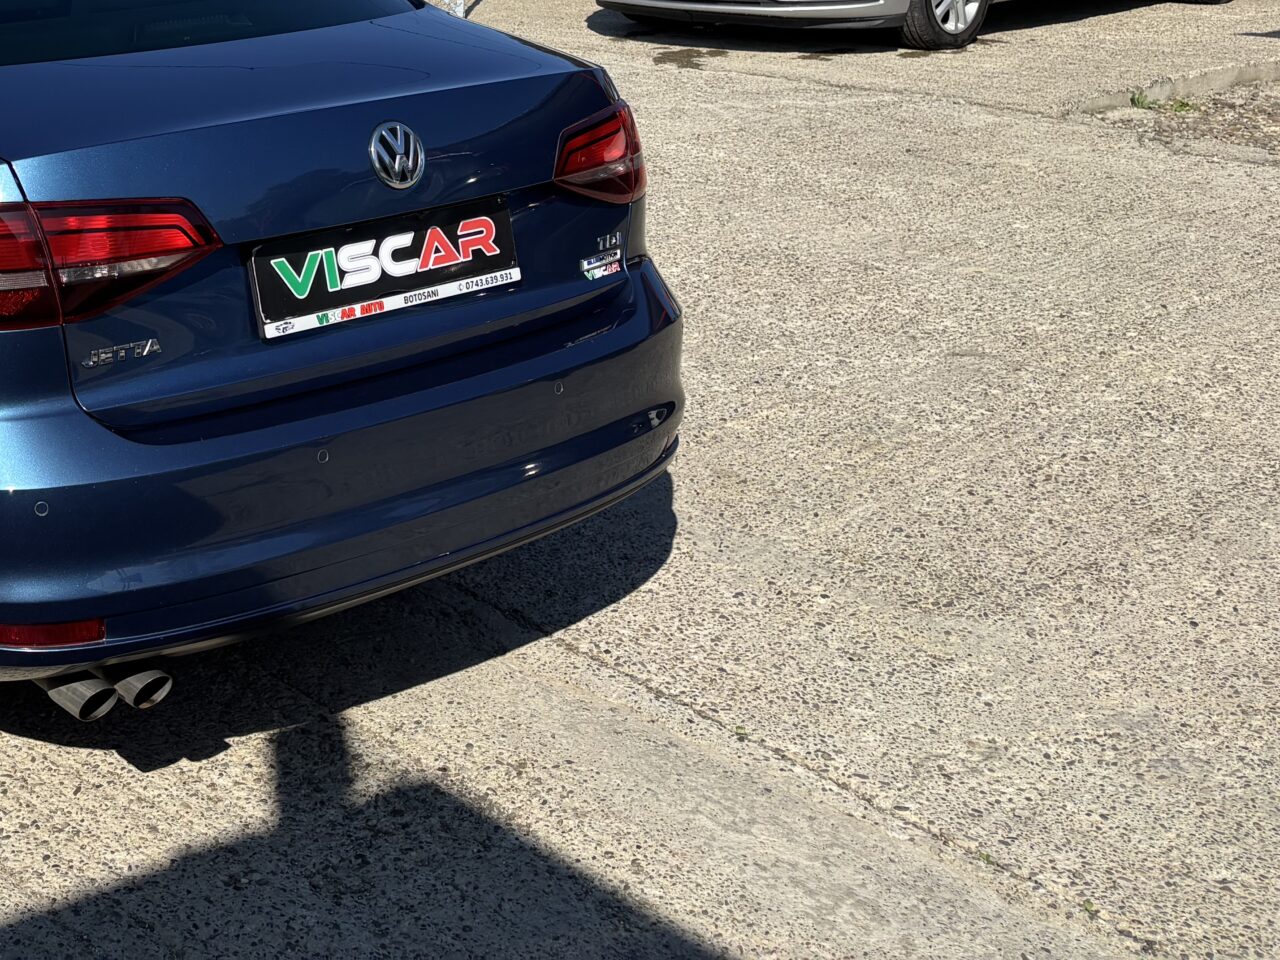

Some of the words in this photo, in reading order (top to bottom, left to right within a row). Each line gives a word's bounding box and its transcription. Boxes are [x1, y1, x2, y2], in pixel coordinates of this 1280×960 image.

[270, 216, 501, 299] VISCAR
[316, 306, 357, 326] VISCAR
[360, 300, 385, 315] AUTO
[403, 288, 440, 305] BOTOSANI
[465, 271, 513, 290] 0743.639.931
[81, 339, 162, 368] JETTA
